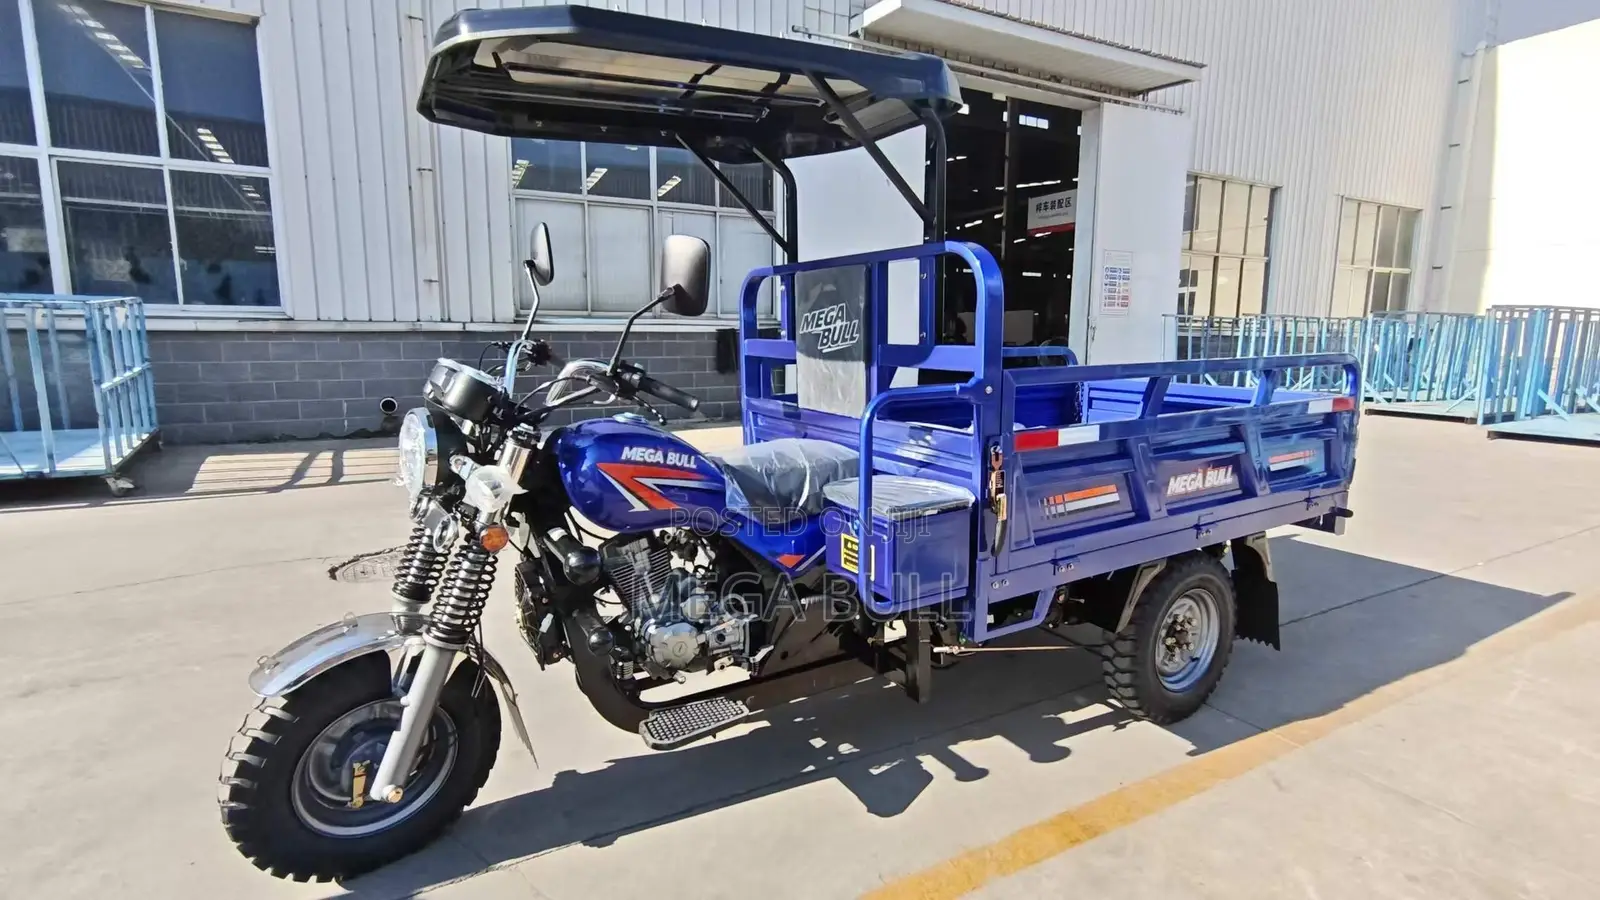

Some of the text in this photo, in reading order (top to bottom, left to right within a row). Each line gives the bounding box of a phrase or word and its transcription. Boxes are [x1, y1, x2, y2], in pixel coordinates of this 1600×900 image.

[799, 303, 846, 334] MEGA
[817, 319, 860, 350] BULL
[621, 446, 697, 468] MEGA BULL
[1167, 465, 1233, 495] MEGA BULL
